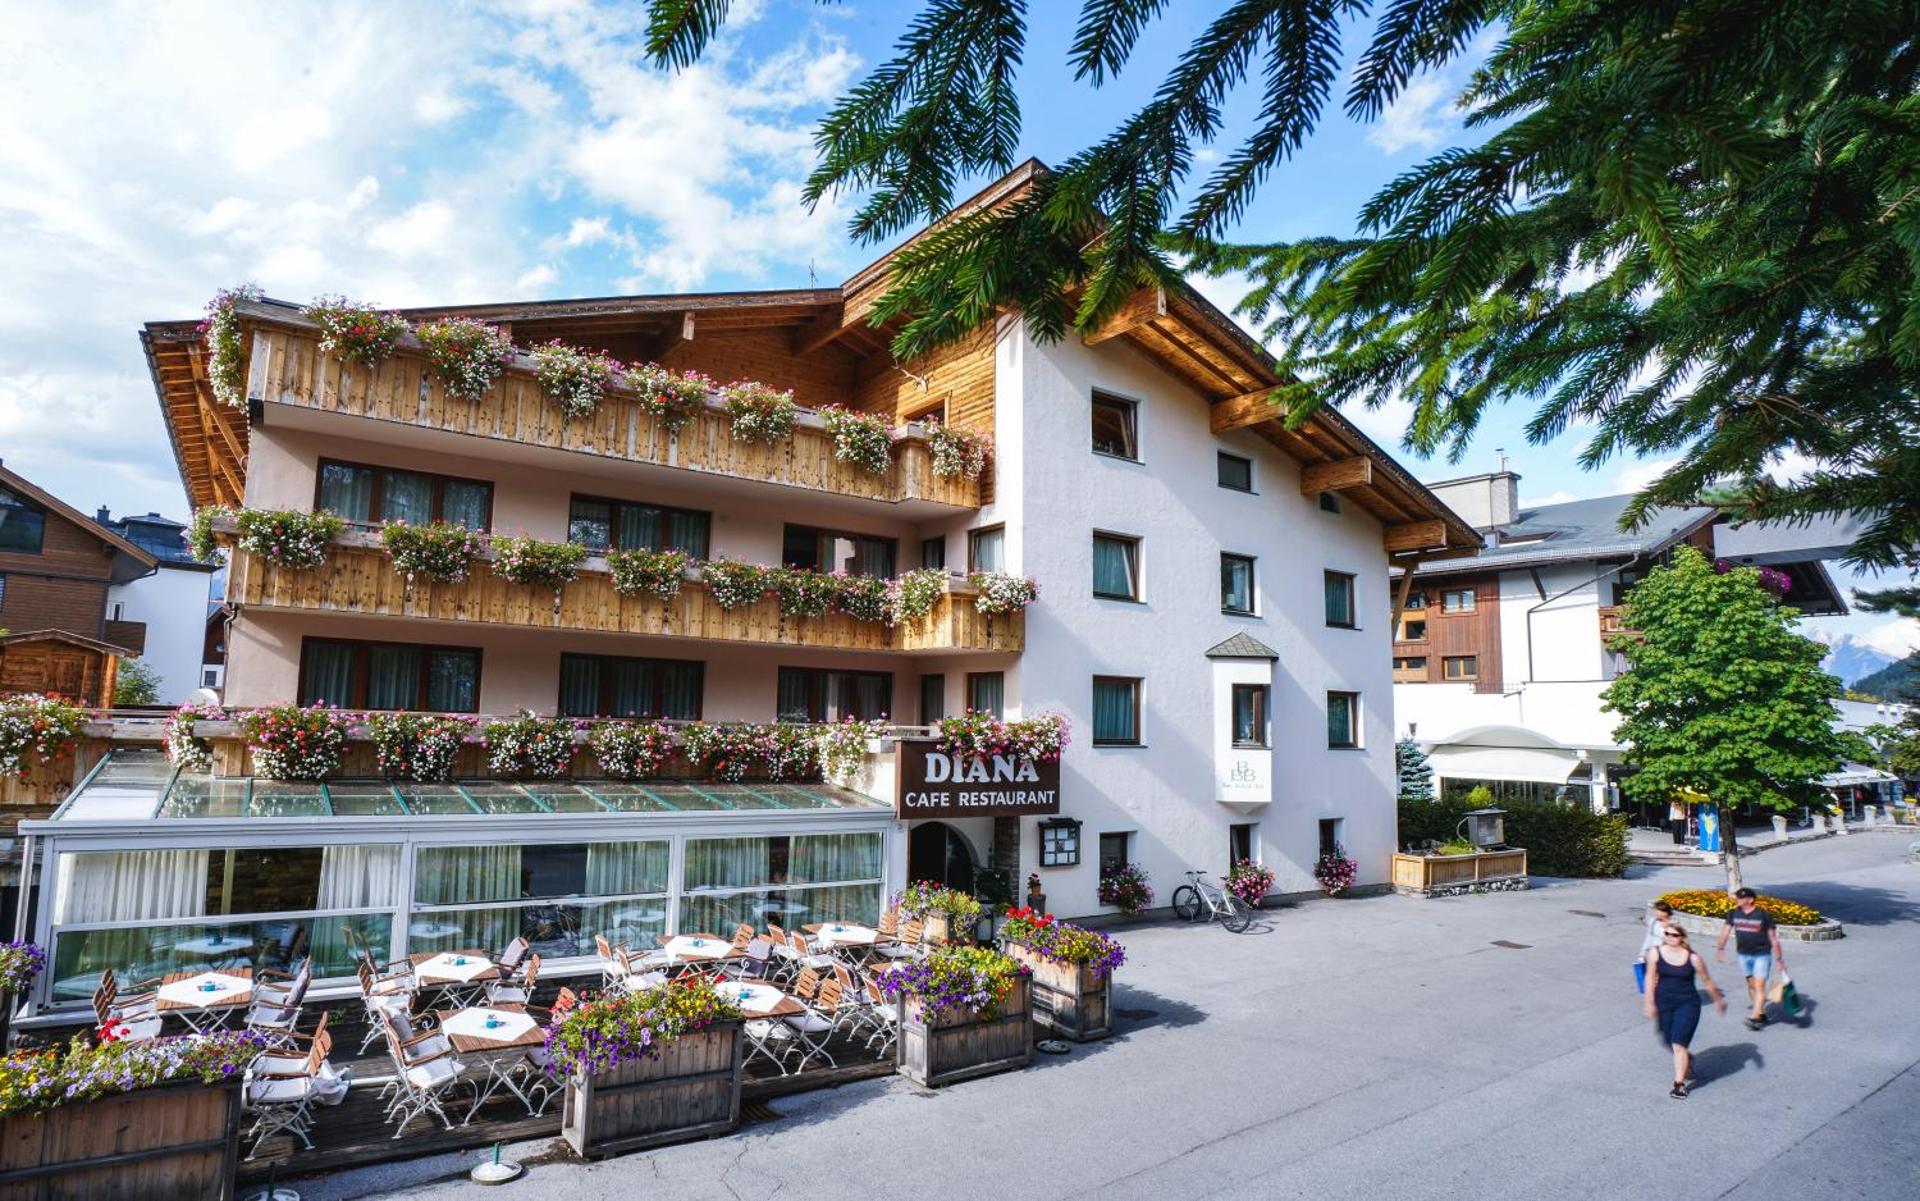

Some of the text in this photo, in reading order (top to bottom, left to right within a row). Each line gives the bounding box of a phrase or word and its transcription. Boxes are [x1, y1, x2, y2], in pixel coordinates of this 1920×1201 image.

[924, 752, 1040, 783] DIANA
[905, 790, 1056, 808] CAFE RESTAURANT
